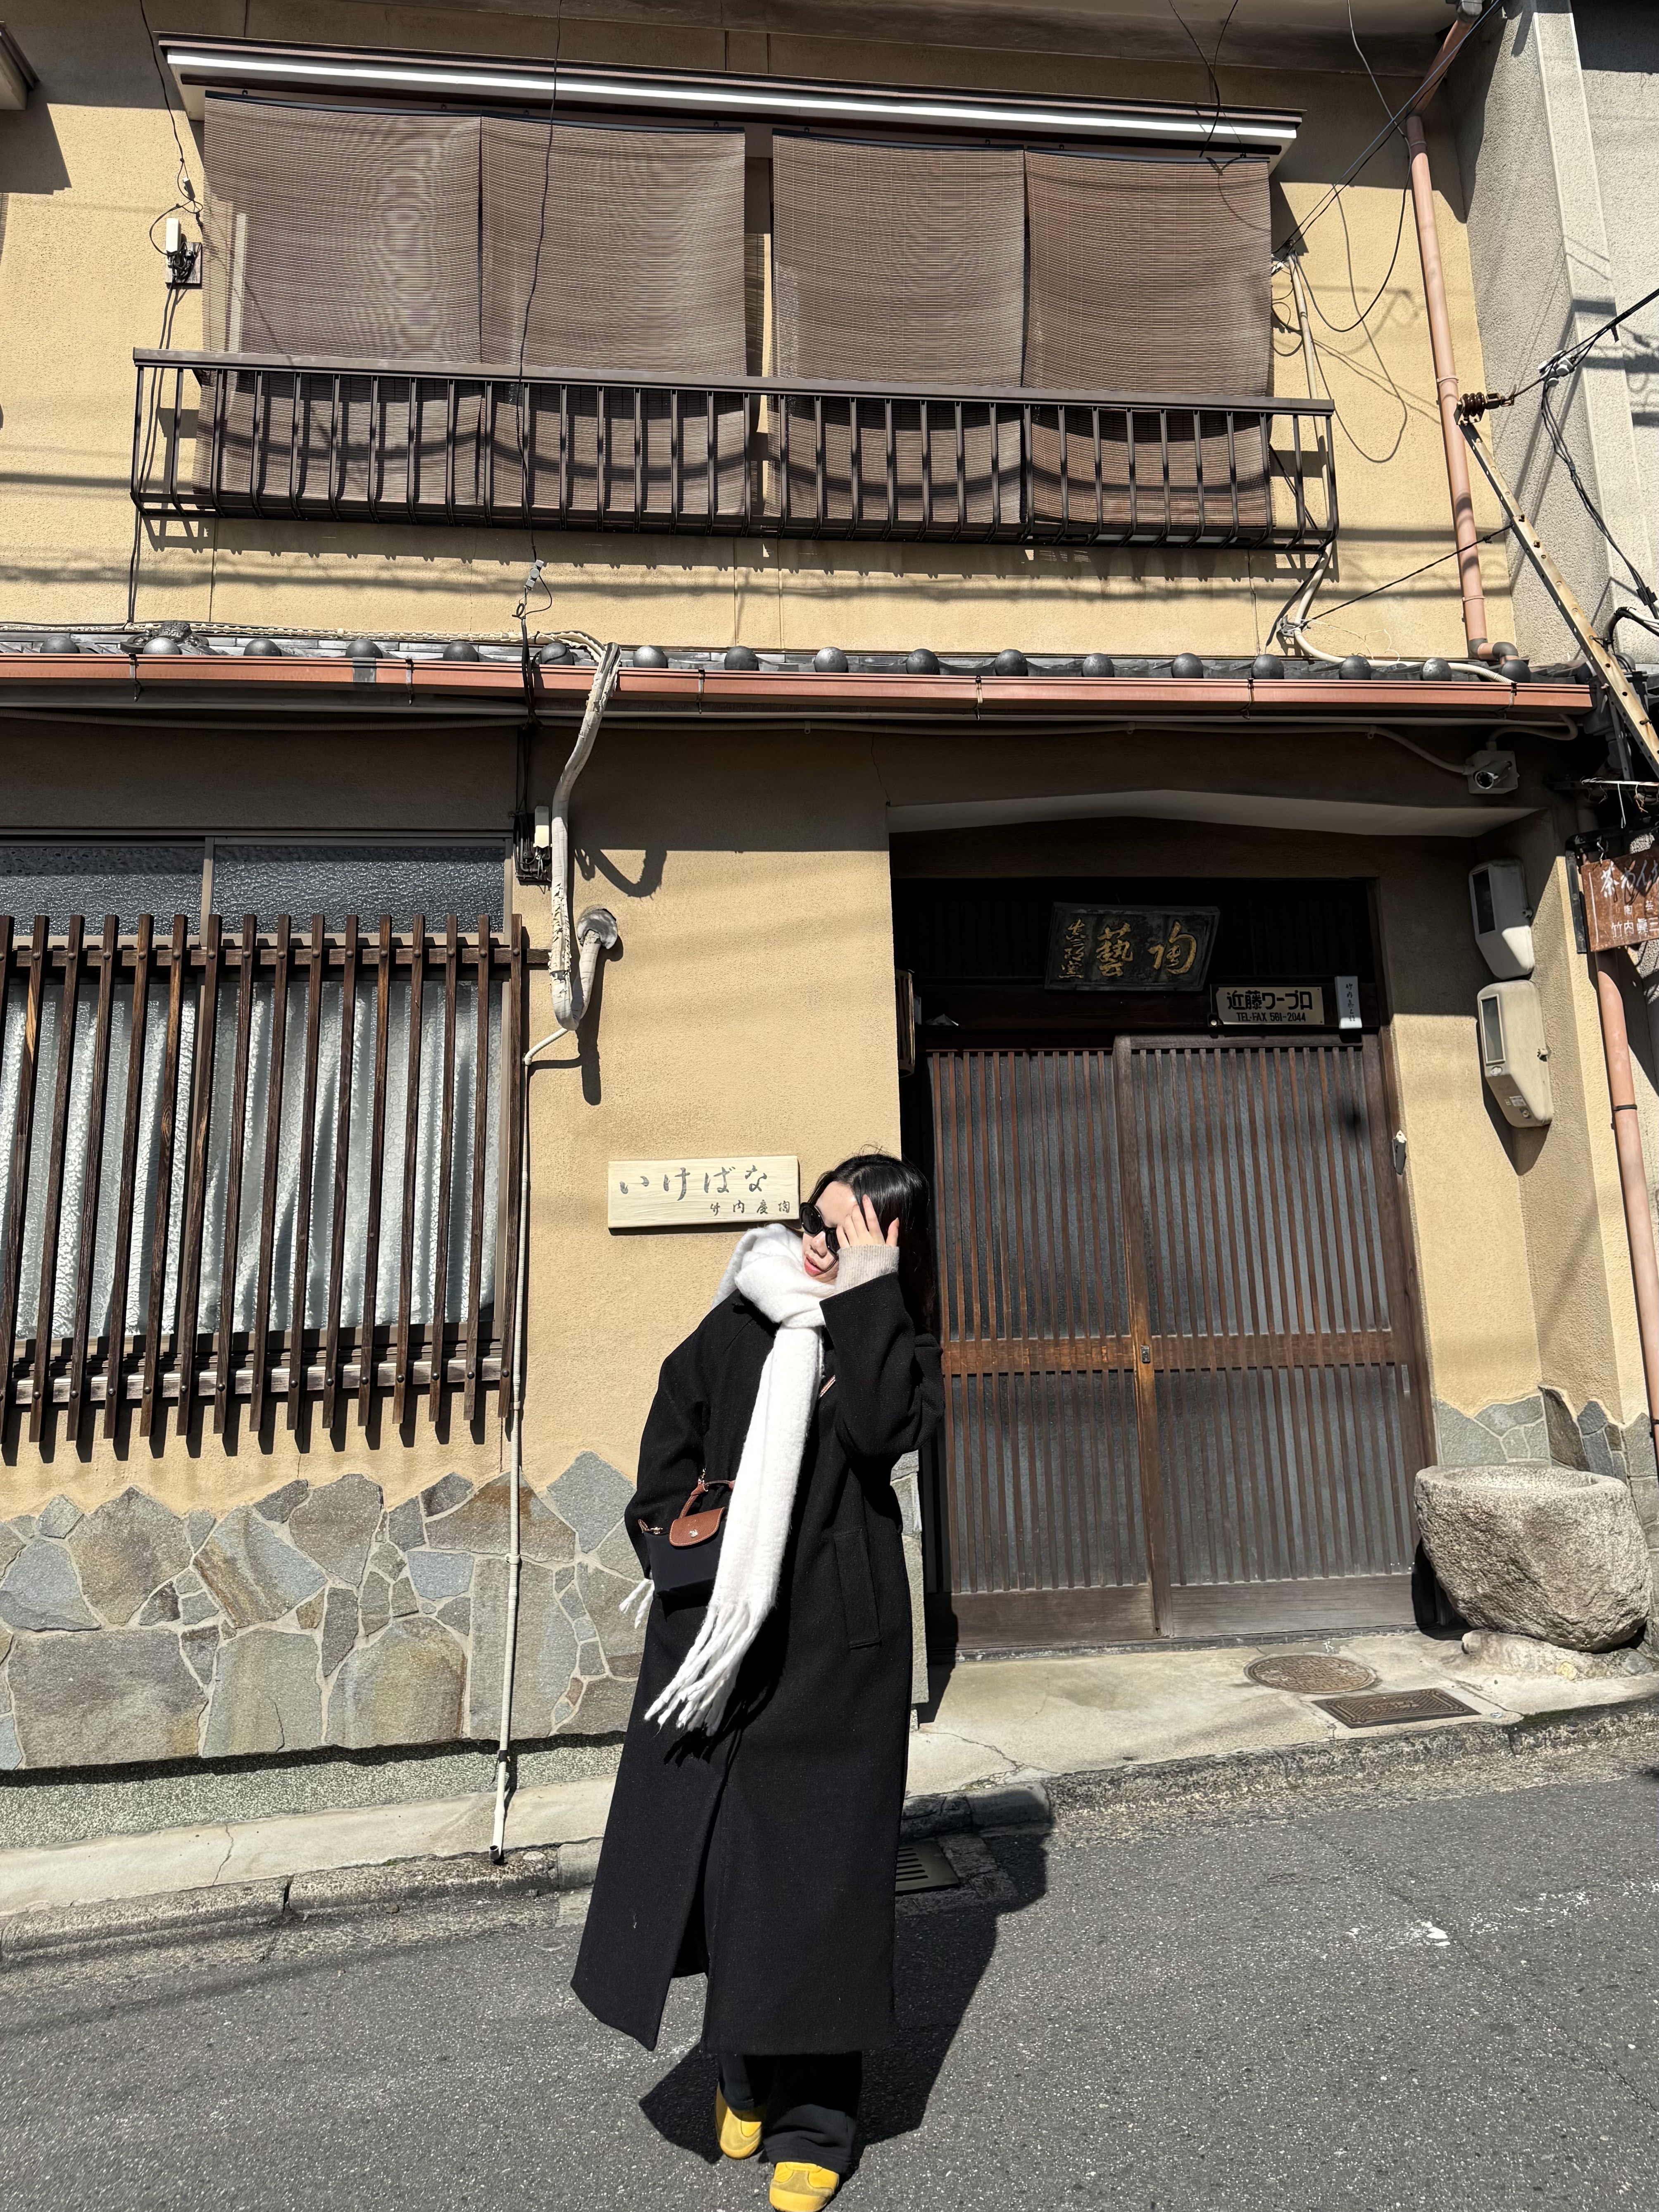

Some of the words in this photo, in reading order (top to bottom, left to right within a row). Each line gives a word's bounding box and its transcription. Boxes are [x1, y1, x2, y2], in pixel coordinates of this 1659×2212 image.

[1227, 990, 1313, 1010] 近藤ワープロ
[1270, 1012, 1306, 1021] 561-2044
[619, 1164, 767, 1201] いけばな
